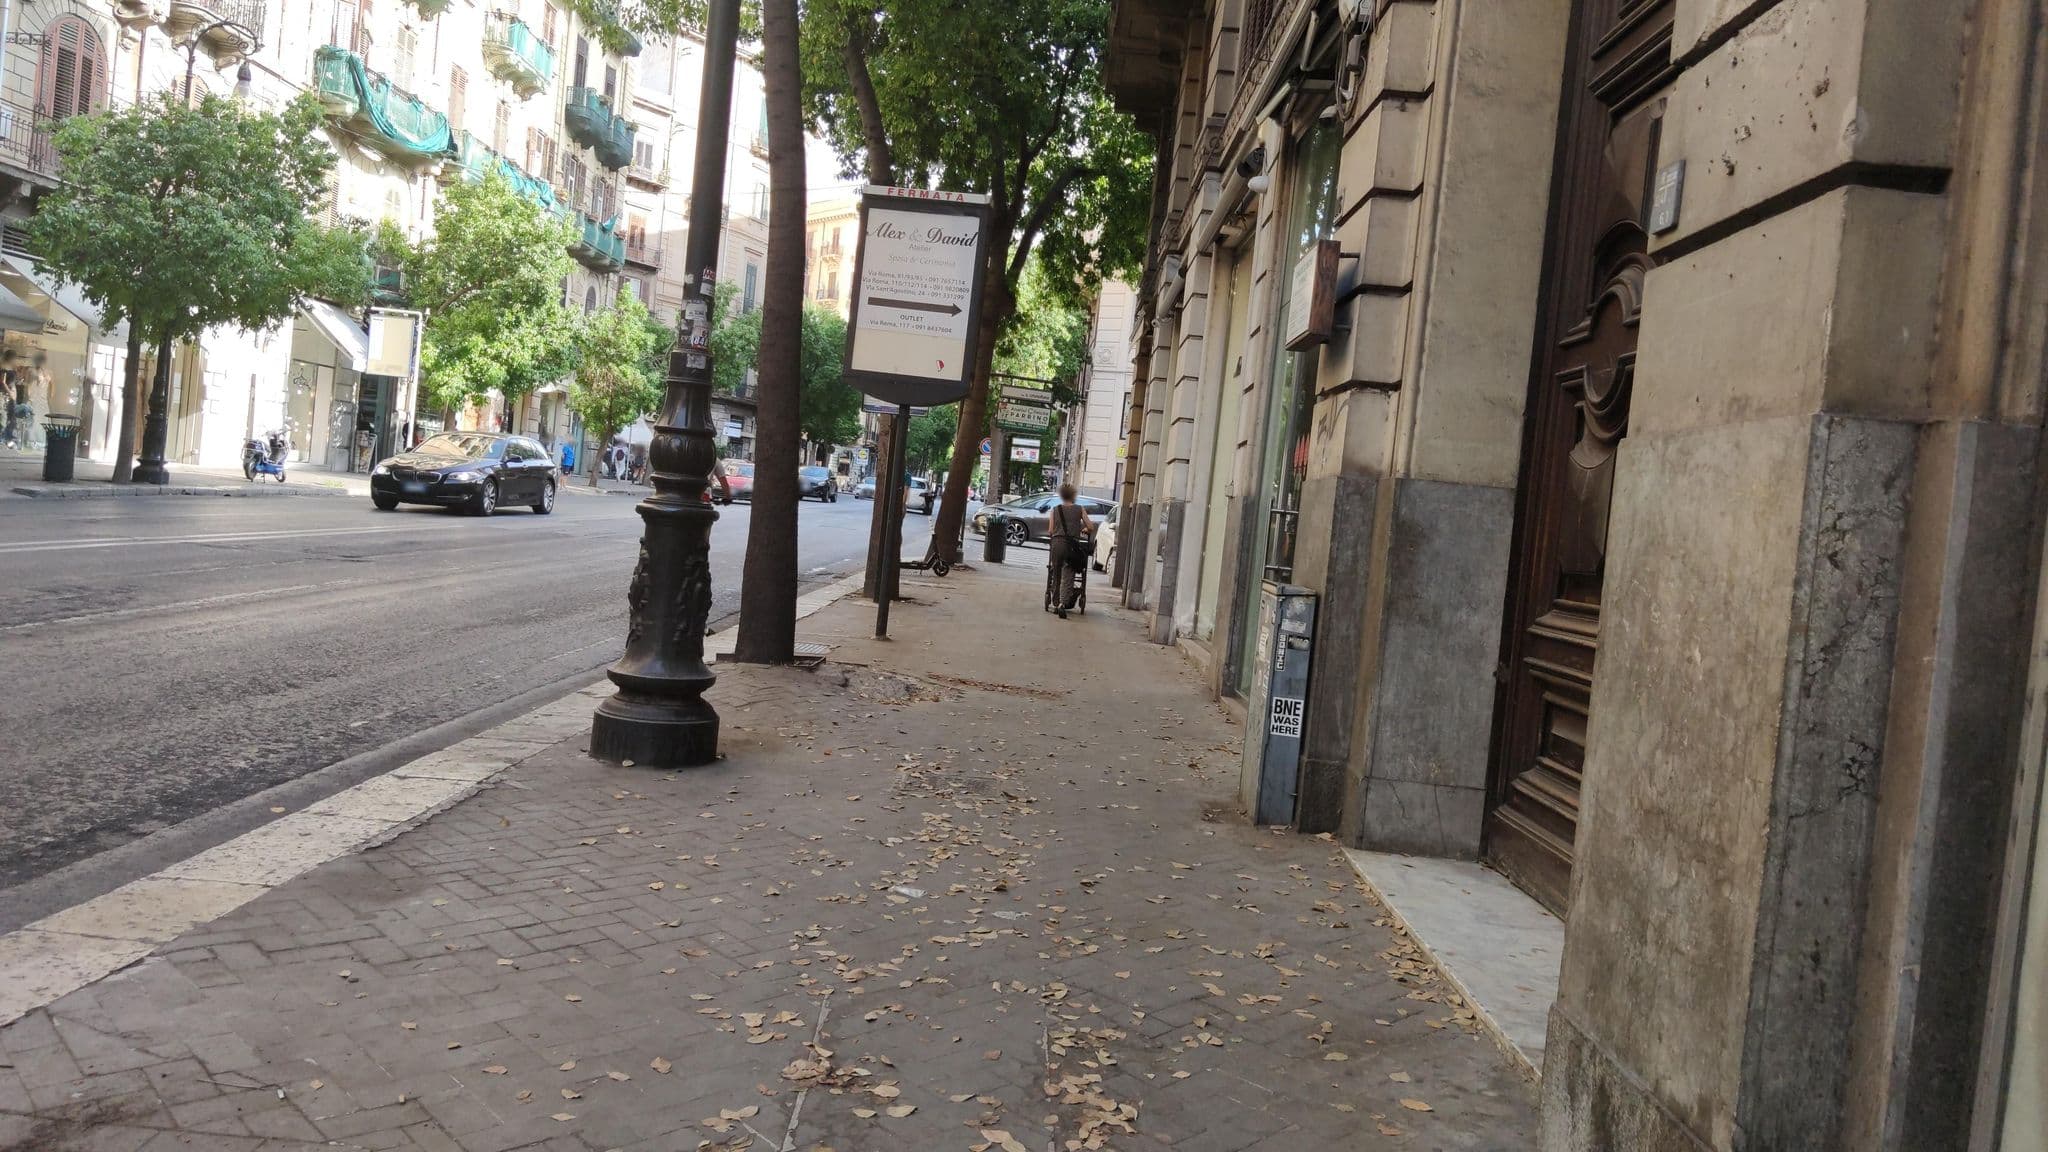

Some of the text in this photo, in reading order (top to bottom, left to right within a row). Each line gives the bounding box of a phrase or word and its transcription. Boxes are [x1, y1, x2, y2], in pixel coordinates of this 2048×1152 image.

[887, 187, 965, 202] FERMATA
[866, 222, 905, 240] Alex
[926, 227, 979, 247] David
[900, 314, 924, 322] OUTLET
[1274, 699, 1301, 716] BNE
[1273, 715, 1299, 726] WAS
[1271, 724, 1298, 736] HERE
